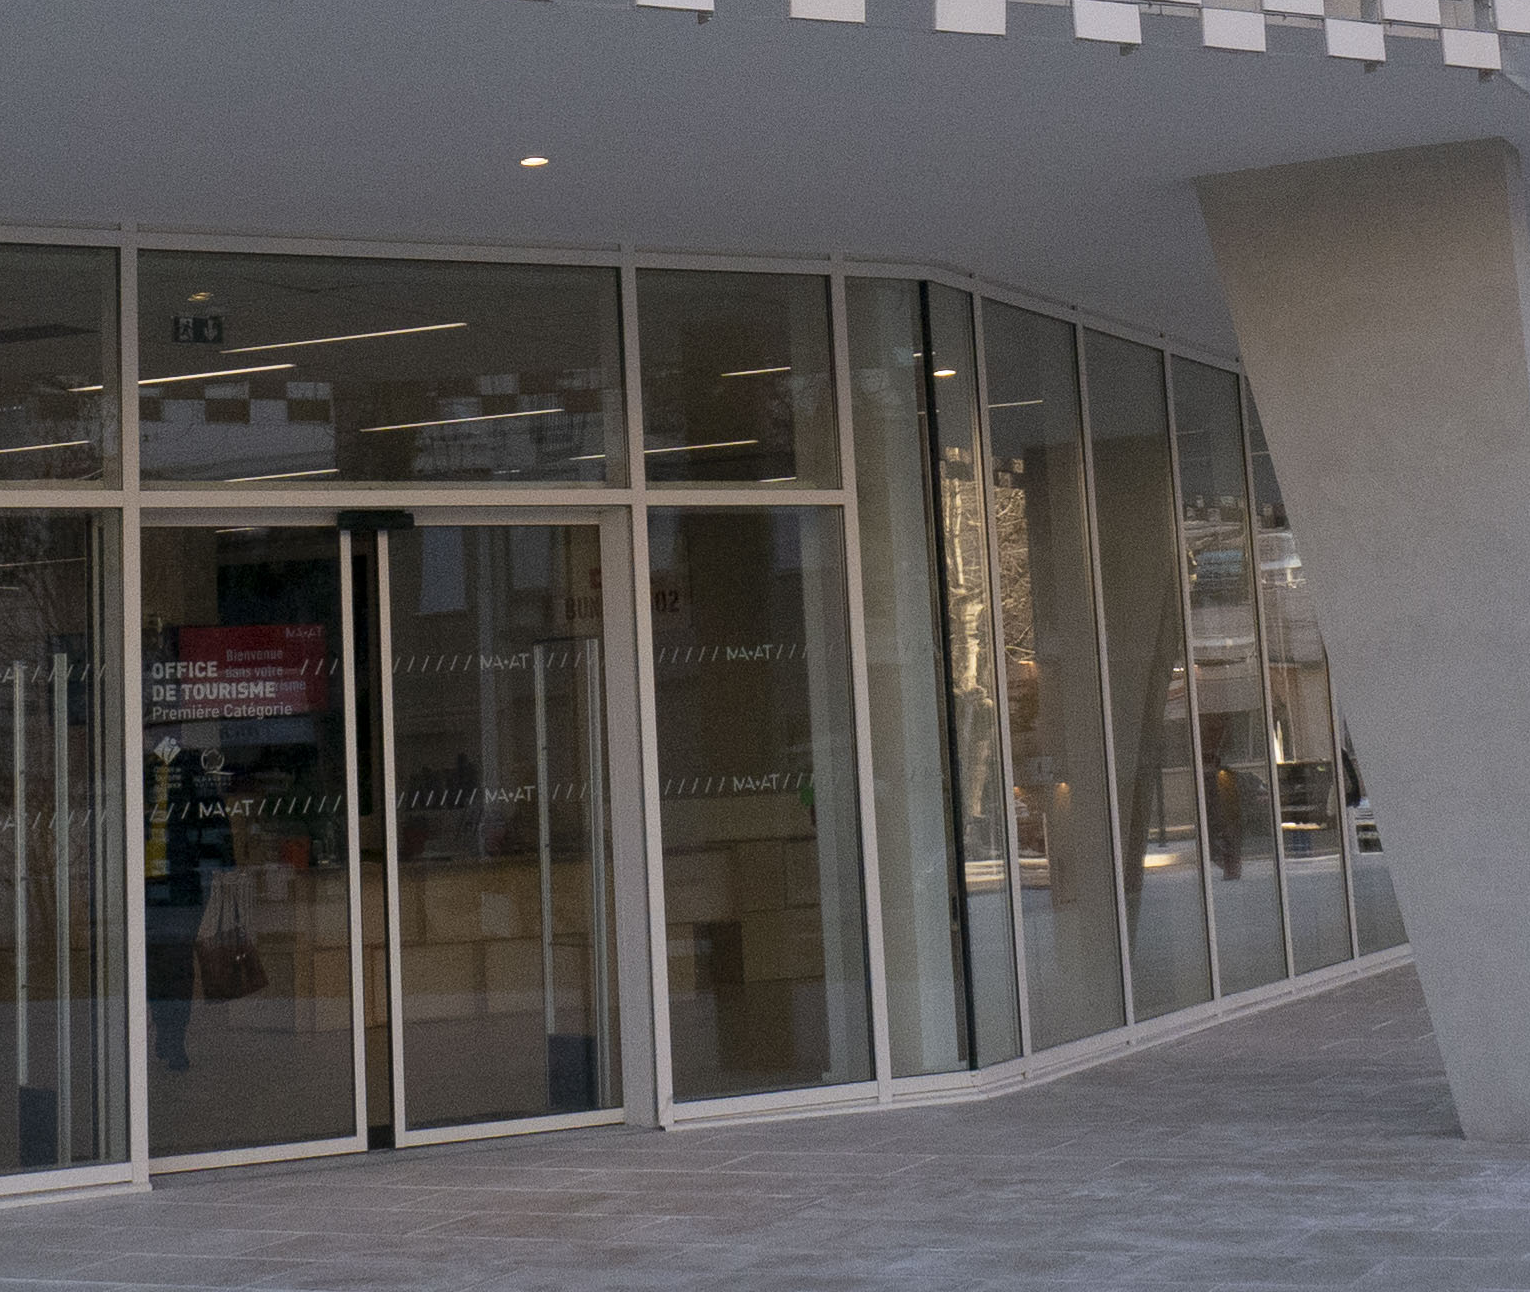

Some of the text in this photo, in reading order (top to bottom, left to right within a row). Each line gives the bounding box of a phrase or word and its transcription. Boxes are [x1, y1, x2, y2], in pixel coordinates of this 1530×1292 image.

[226, 649, 284, 662] Bienvenue
[152, 661, 218, 680] OFFICE
[254, 665, 284, 678] votre
[152, 681, 277, 702] DE TOURISME
[223, 703, 293, 720] Catégorie
